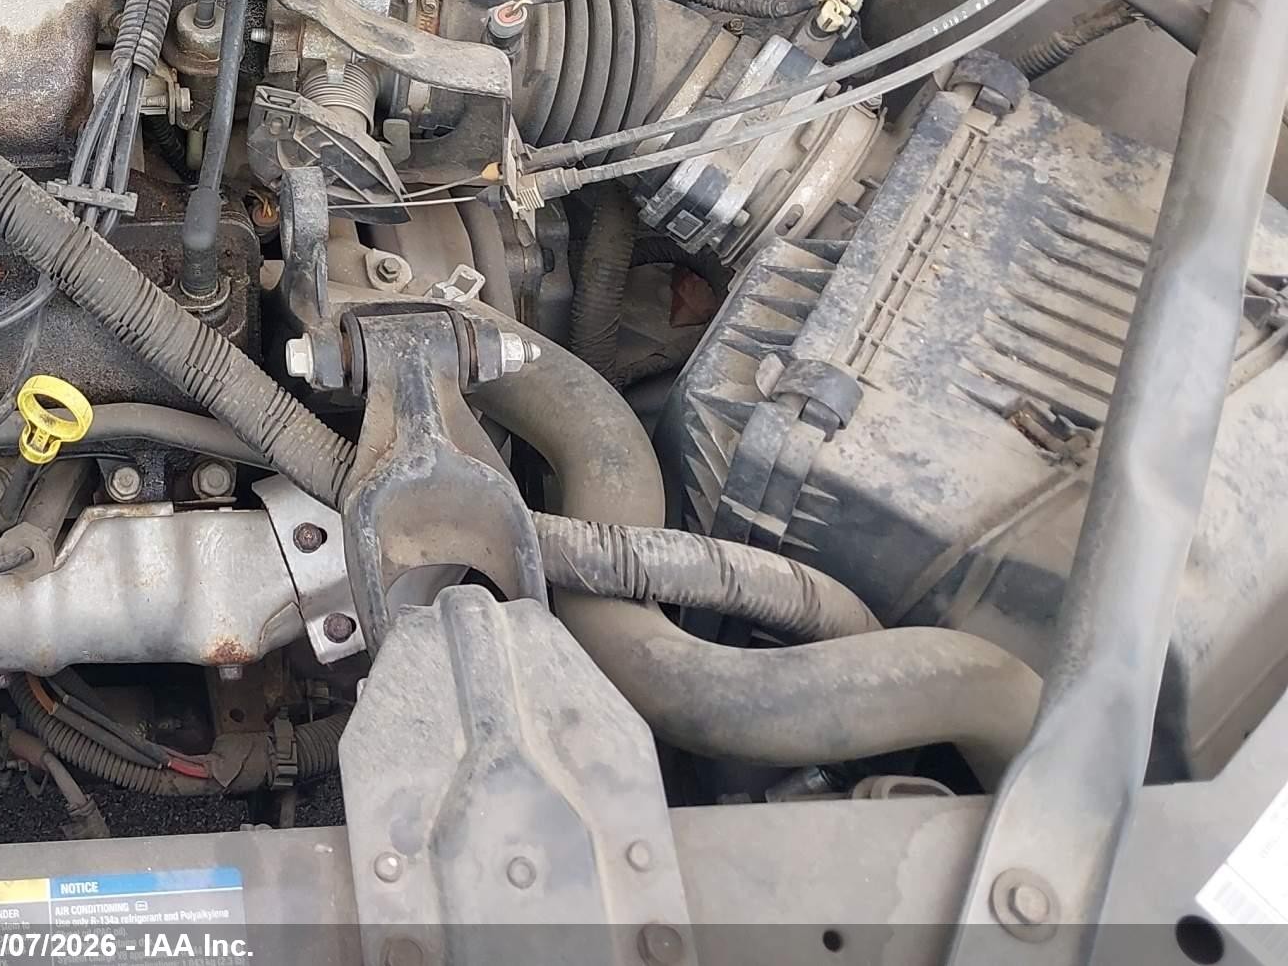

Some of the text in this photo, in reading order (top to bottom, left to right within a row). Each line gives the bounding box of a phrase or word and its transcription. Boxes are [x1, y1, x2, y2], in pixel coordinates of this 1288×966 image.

[60, 882, 98, 893] NOTICE
[55, 903, 129, 916] AIR CONDITIONING
[55, 908, 229, 928] Use only R-134a refrigerant and Polyalkylene
